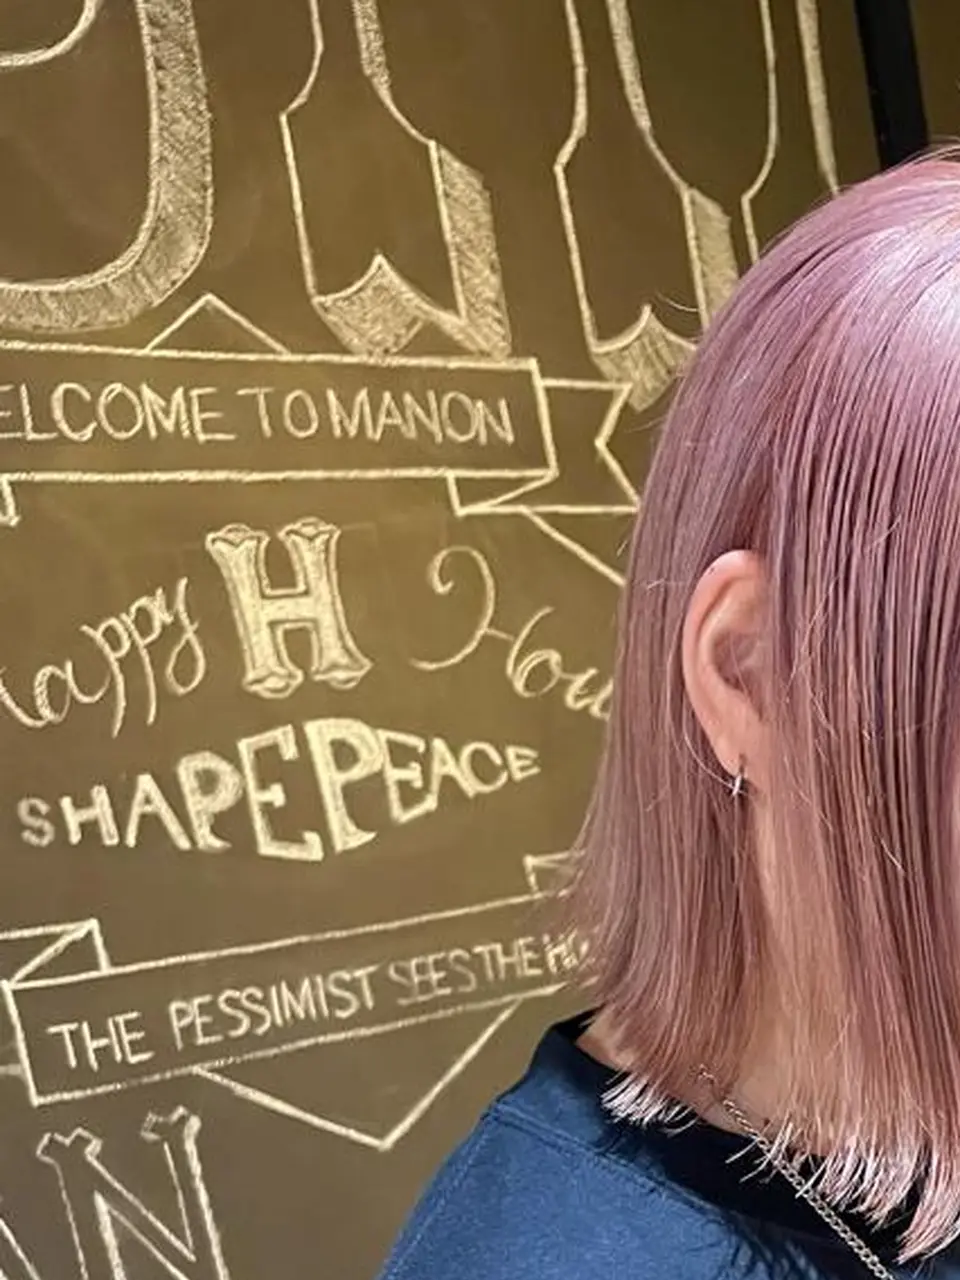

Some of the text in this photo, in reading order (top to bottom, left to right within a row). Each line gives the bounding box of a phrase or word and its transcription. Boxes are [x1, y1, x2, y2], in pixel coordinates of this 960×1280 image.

[236, 386, 319, 438] TO
[325, 386, 515, 445] MANON
[0, 576, 206, 739] appy
[408, 545, 615, 722] Hou
[17, 716, 542, 862] SHAPE PEACE
[46, 1010, 155, 1073] THE
[168, 963, 380, 1052] PESSIMIST
[388, 947, 478, 1006] SEES
[472, 936, 543, 984] THE
